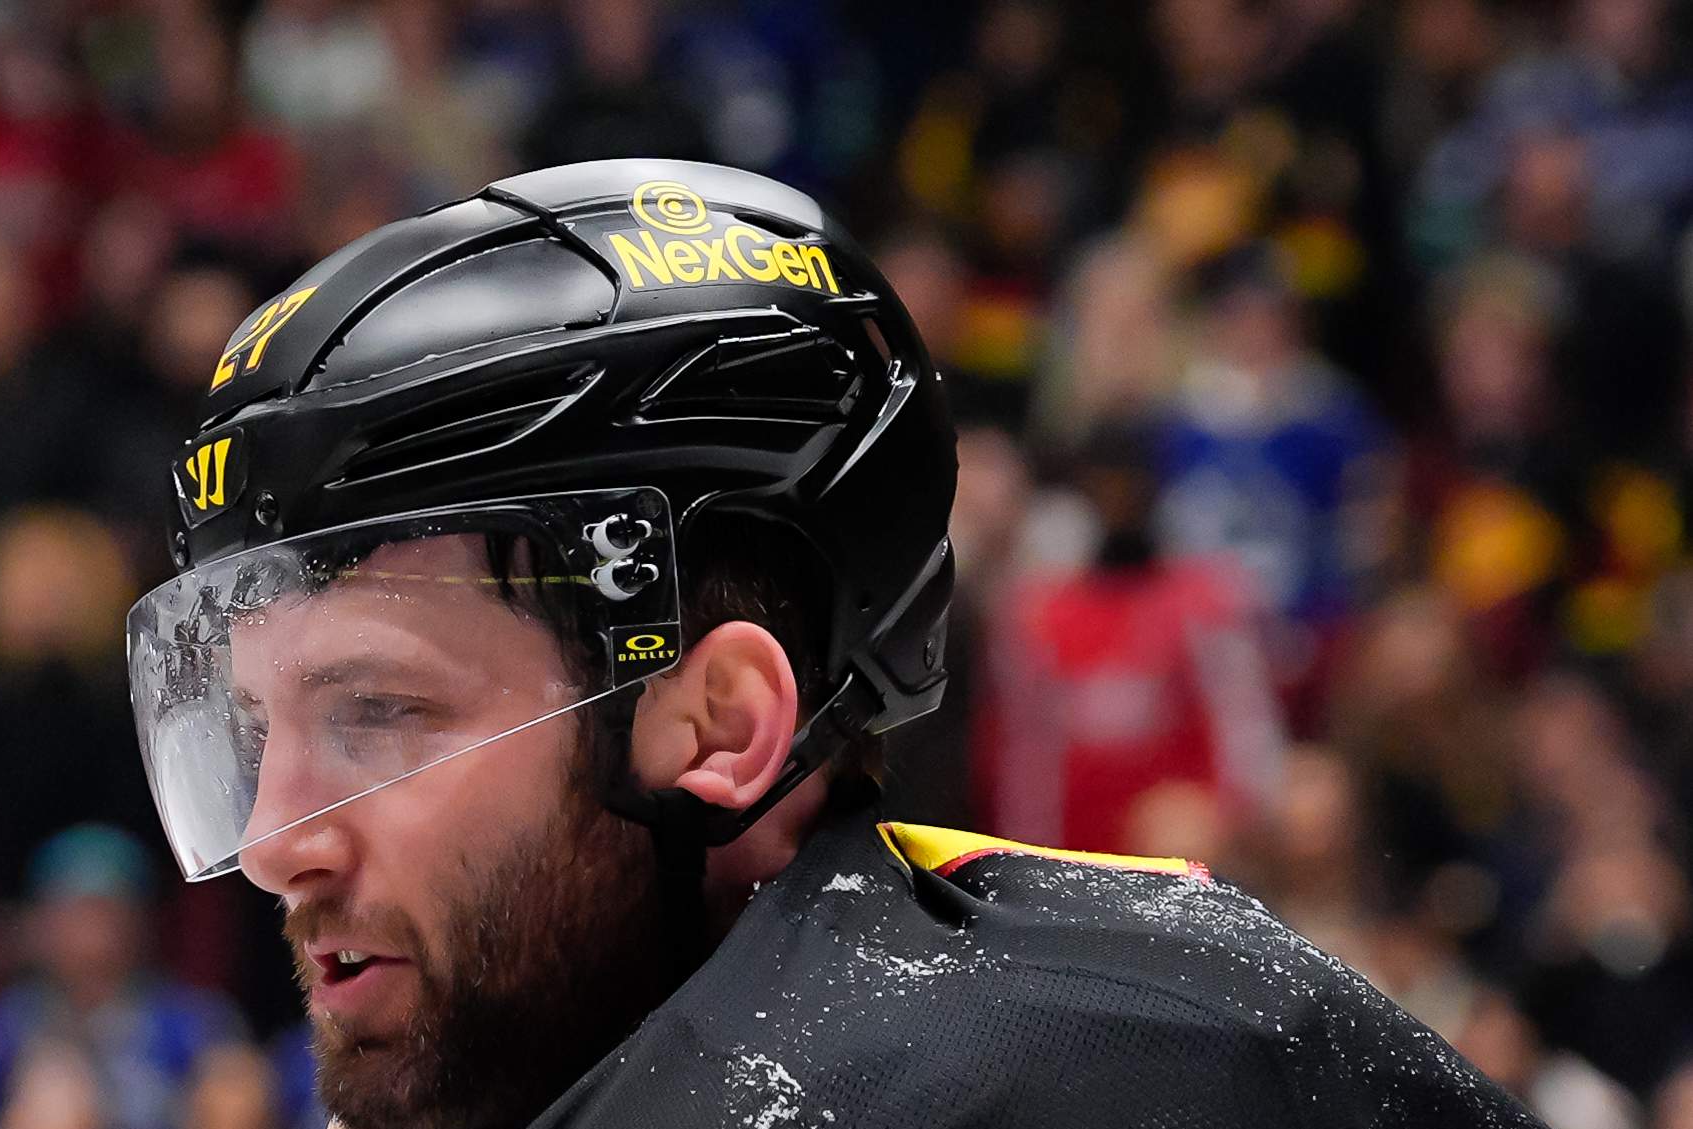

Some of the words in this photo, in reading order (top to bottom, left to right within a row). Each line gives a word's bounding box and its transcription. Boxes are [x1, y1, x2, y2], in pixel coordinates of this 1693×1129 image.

[608, 225, 841, 295] NexGen
[208, 286, 320, 397] 27
[617, 650, 676, 662] OAKLEY
